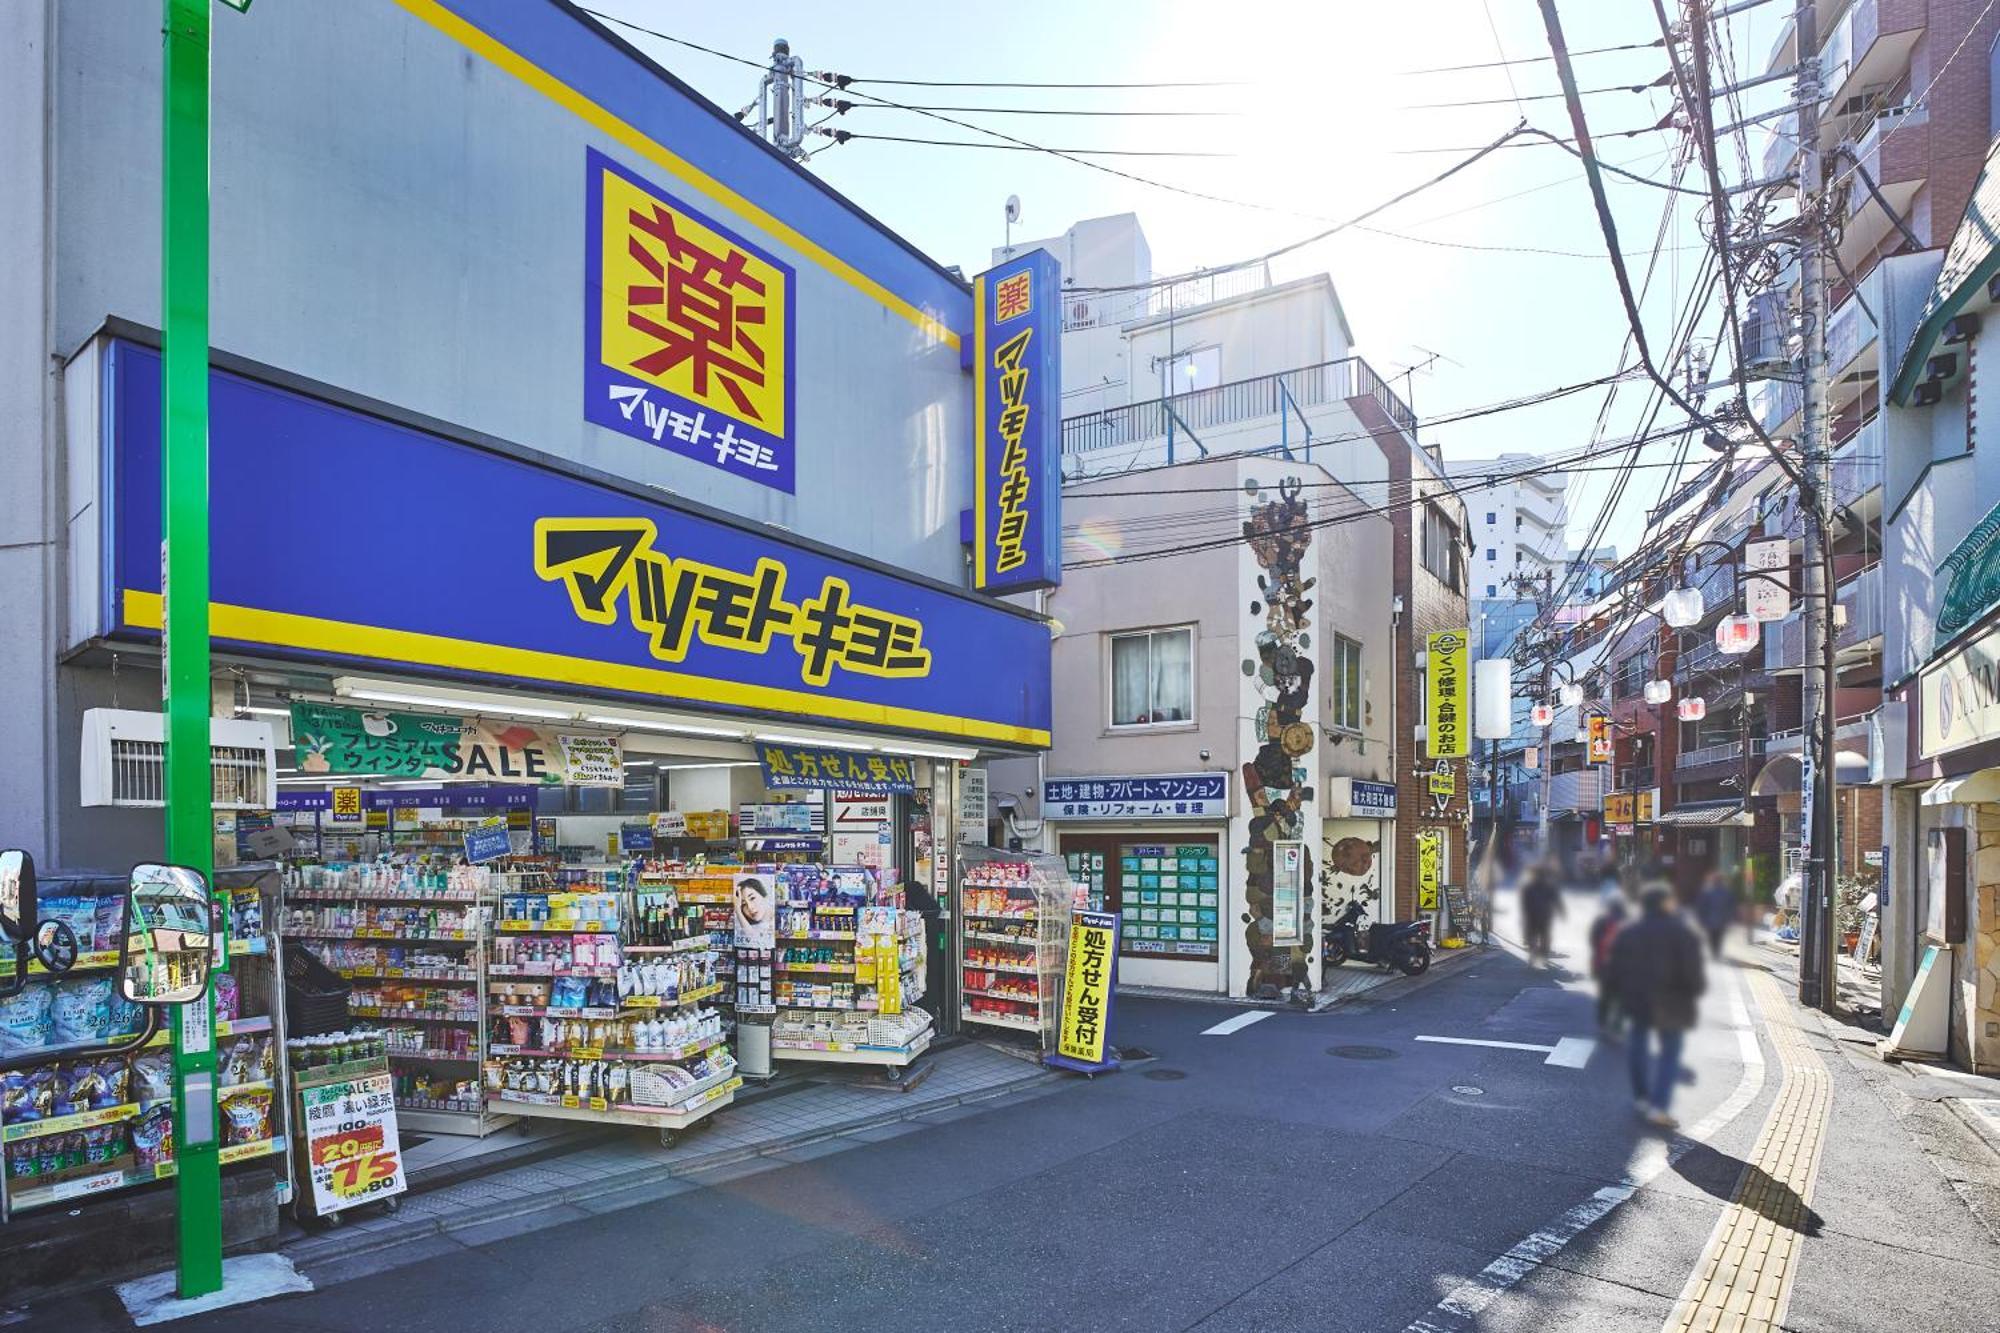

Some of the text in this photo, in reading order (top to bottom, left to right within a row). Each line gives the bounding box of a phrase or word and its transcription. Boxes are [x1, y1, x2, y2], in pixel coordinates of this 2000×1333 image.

[628, 203, 766, 422] 薬
[999, 275, 1029, 320] 薬
[608, 382, 780, 472] マツモトキヨシ
[996, 330, 1031, 572] マツモトキヨシ
[539, 522, 929, 682] マツモトキヨシ
[340, 732, 439, 757] プレミアム
[343, 752, 441, 773] ウィンター
[441, 741, 548, 779] SALE
[764, 747, 912, 783] 処方せん受付
[336, 788, 358, 813] 薬
[1048, 780, 1221, 800] 土地・建物・アパート・マンション
[1063, 802, 1205, 816] 保険・リフォーム・管理
[1075, 929, 1106, 1046] 処方せん受付
[343, 1080, 370, 1097] SALE
[321, 1139, 360, 1164] 20
[333, 1151, 398, 1188] 75
